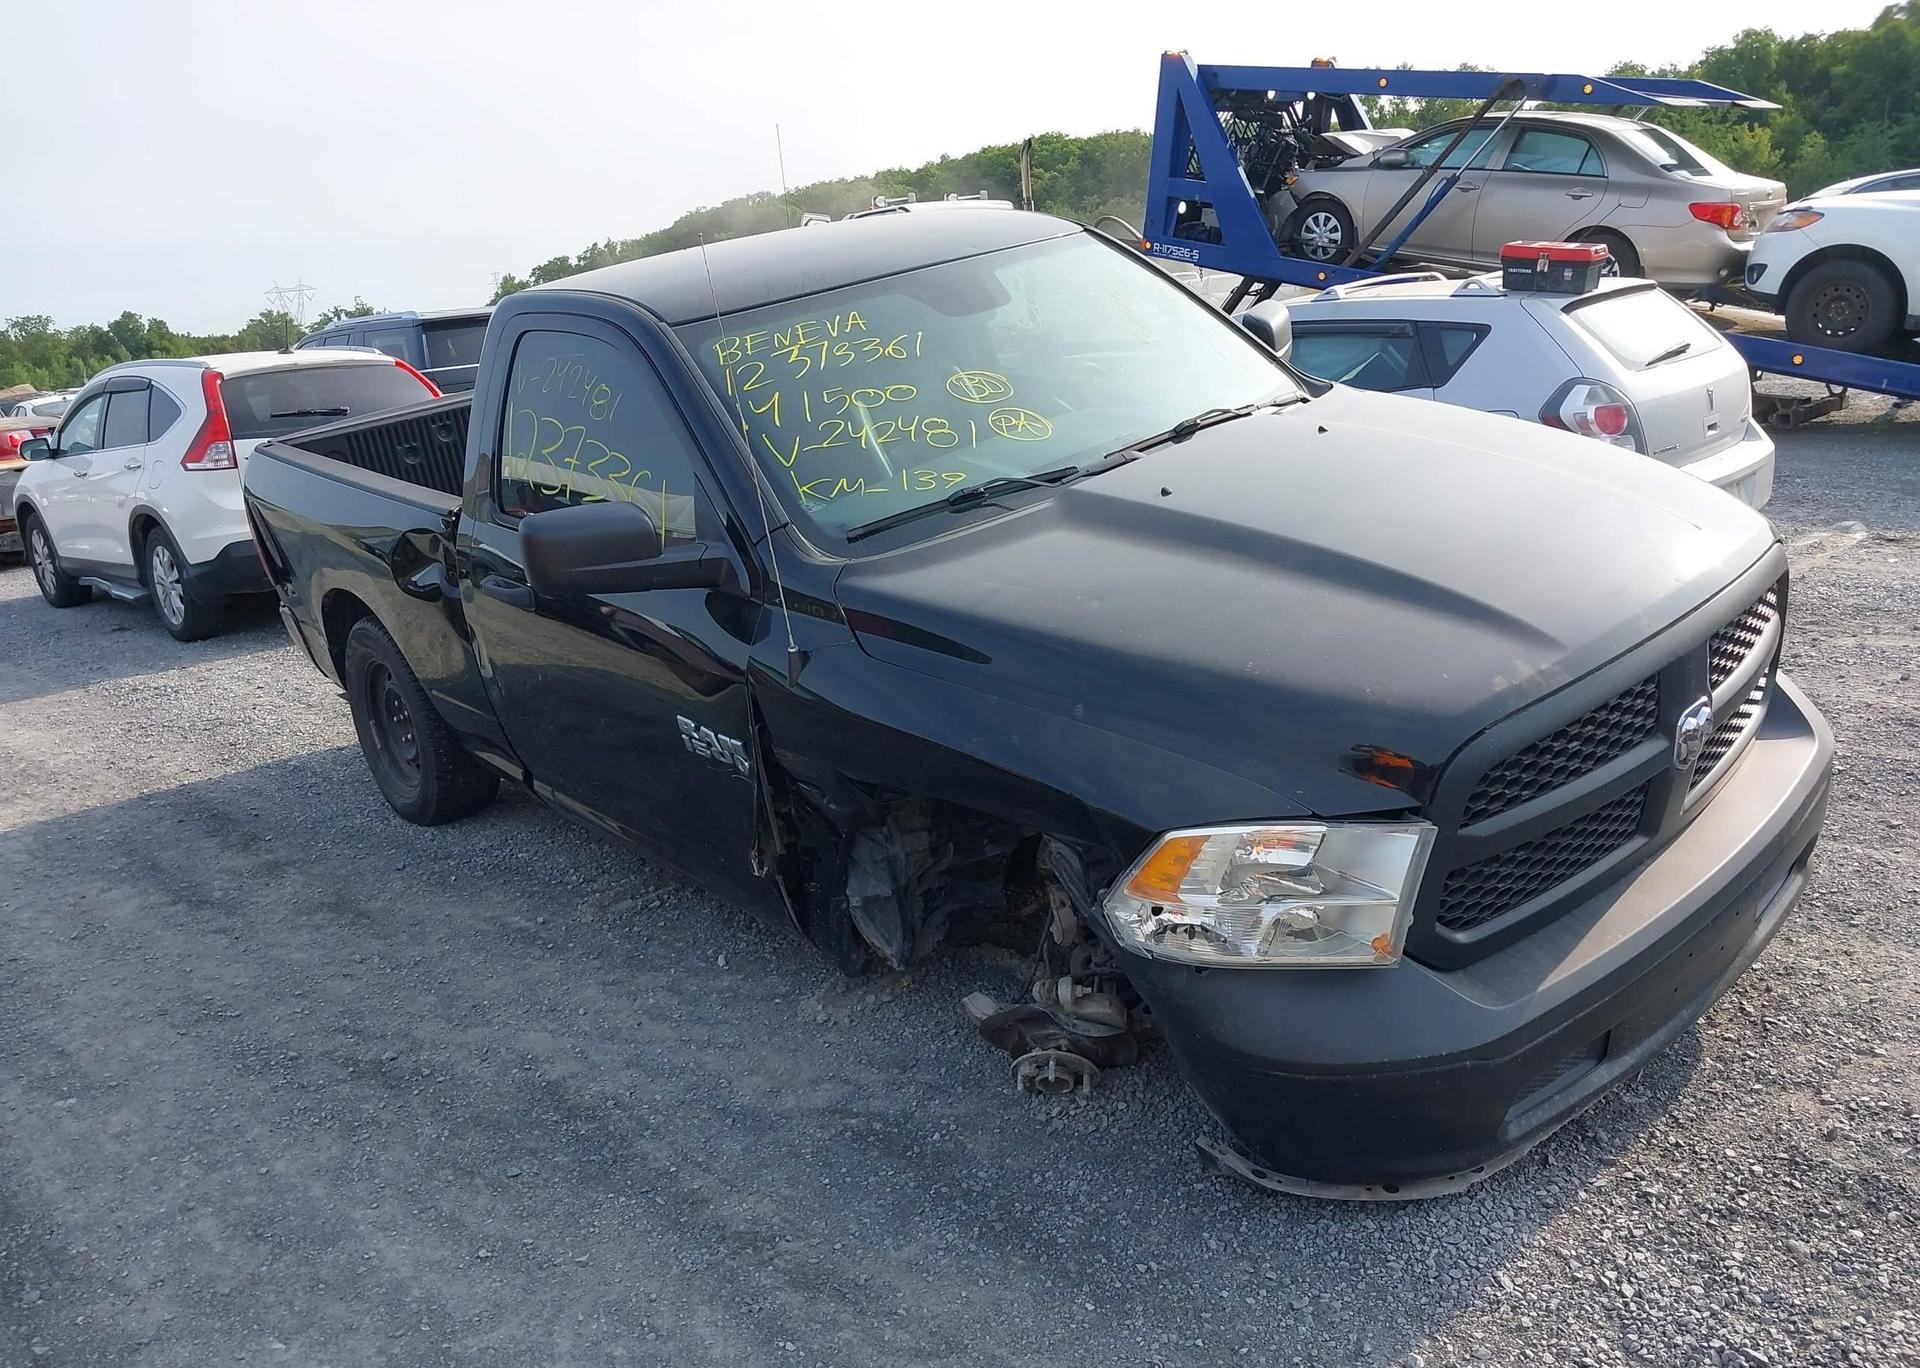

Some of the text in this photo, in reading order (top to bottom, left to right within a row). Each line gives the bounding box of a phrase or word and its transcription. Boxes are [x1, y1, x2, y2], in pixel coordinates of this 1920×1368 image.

[713, 311, 867, 366] BENEVA
[803, 384, 917, 422] 1500
[676, 714, 750, 763] RAM
